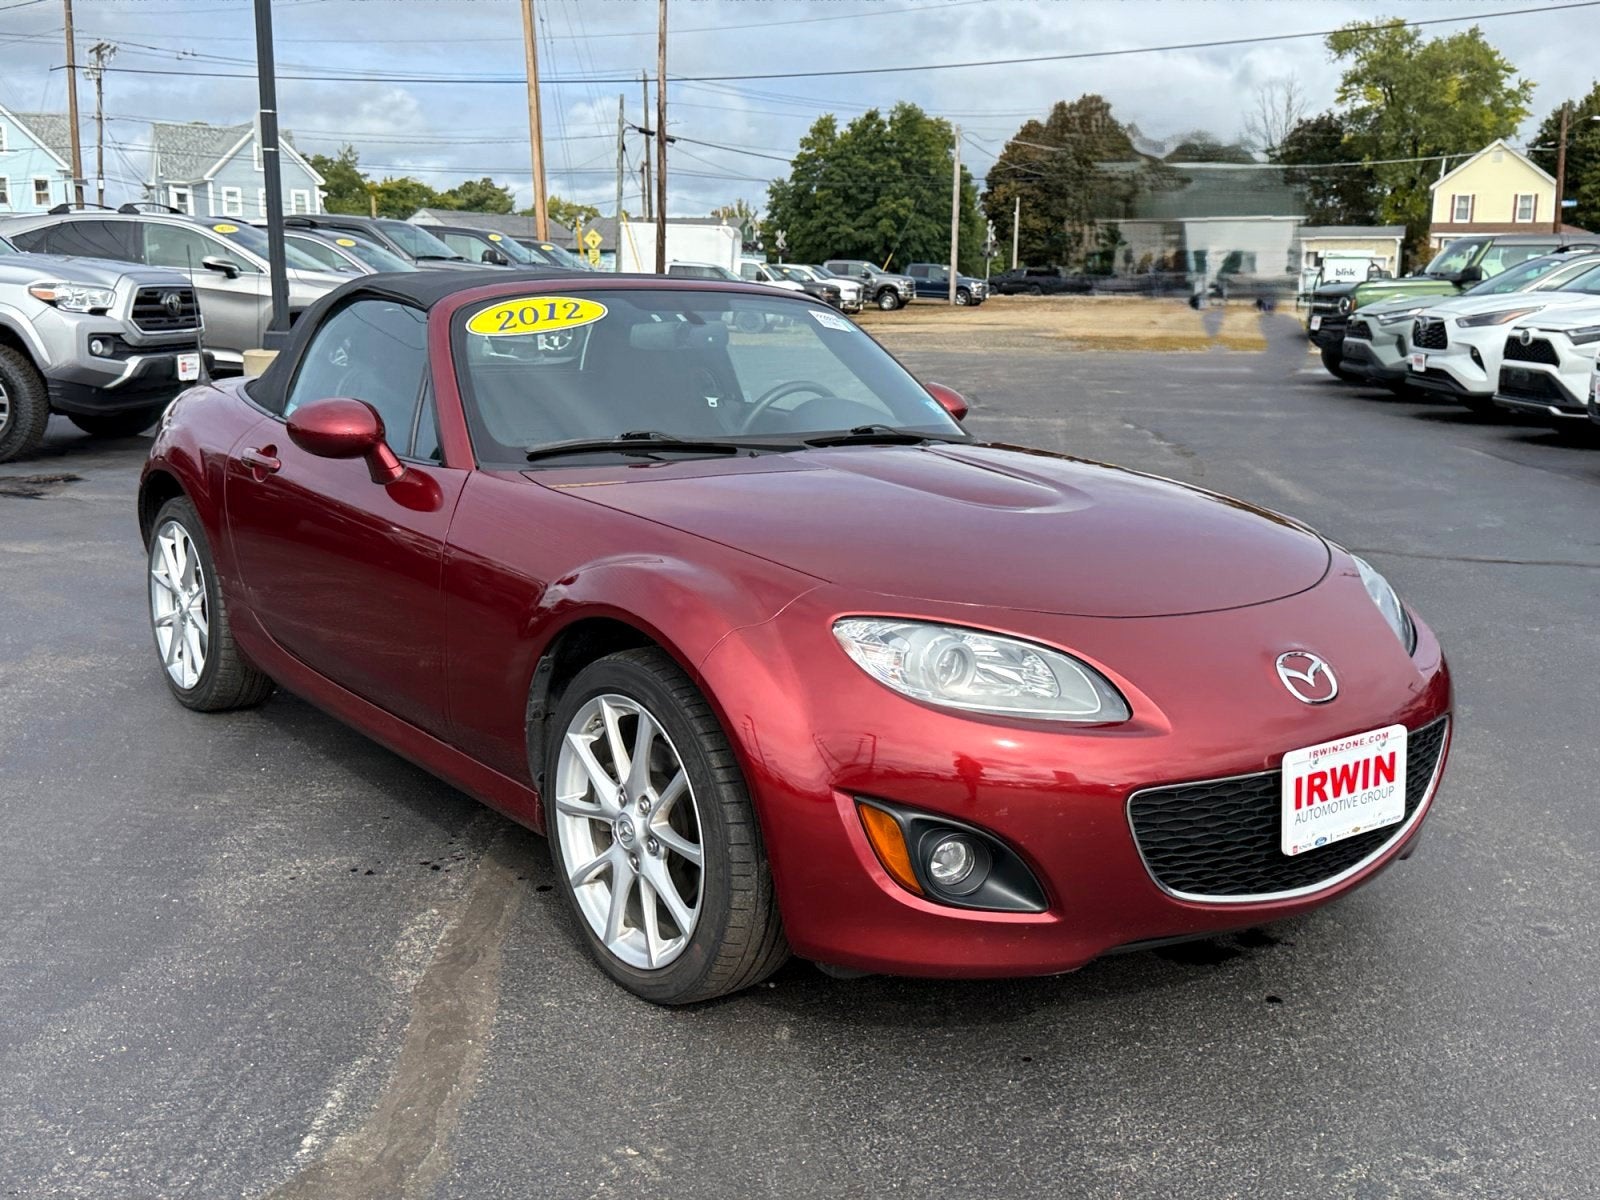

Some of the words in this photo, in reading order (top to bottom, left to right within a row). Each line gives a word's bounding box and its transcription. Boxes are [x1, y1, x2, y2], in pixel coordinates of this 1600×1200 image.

[1335, 268, 1356, 276] blink
[496, 302, 583, 331] 2012
[1308, 732, 1389, 759] IRWINZONE.COM
[1294, 751, 1396, 810] IRWIN
[1294, 796, 1358, 826] AUTOMOTIVE
[1360, 786, 1395, 805] GROUP
